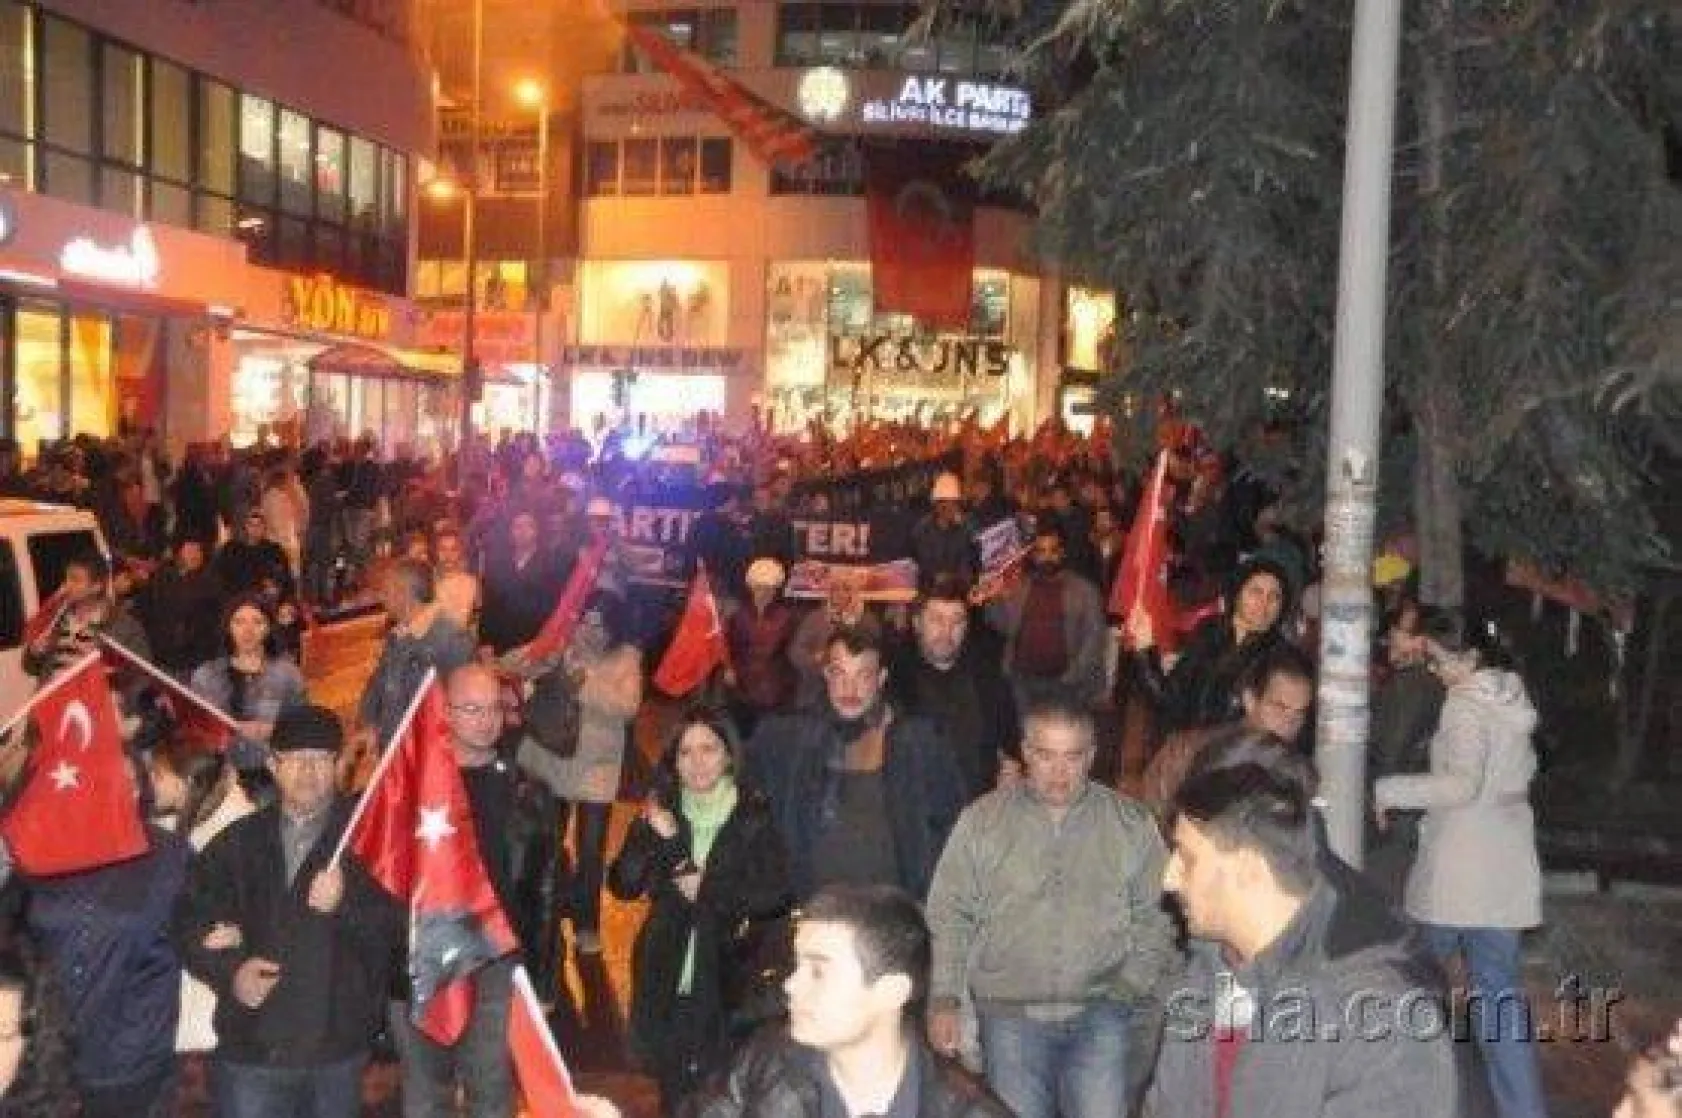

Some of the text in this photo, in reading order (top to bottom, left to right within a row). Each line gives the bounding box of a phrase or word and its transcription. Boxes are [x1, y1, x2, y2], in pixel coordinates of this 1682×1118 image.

[900, 74, 947, 104] AK
[897, 335, 922, 373] &
[931, 338, 1008, 377] JNS
